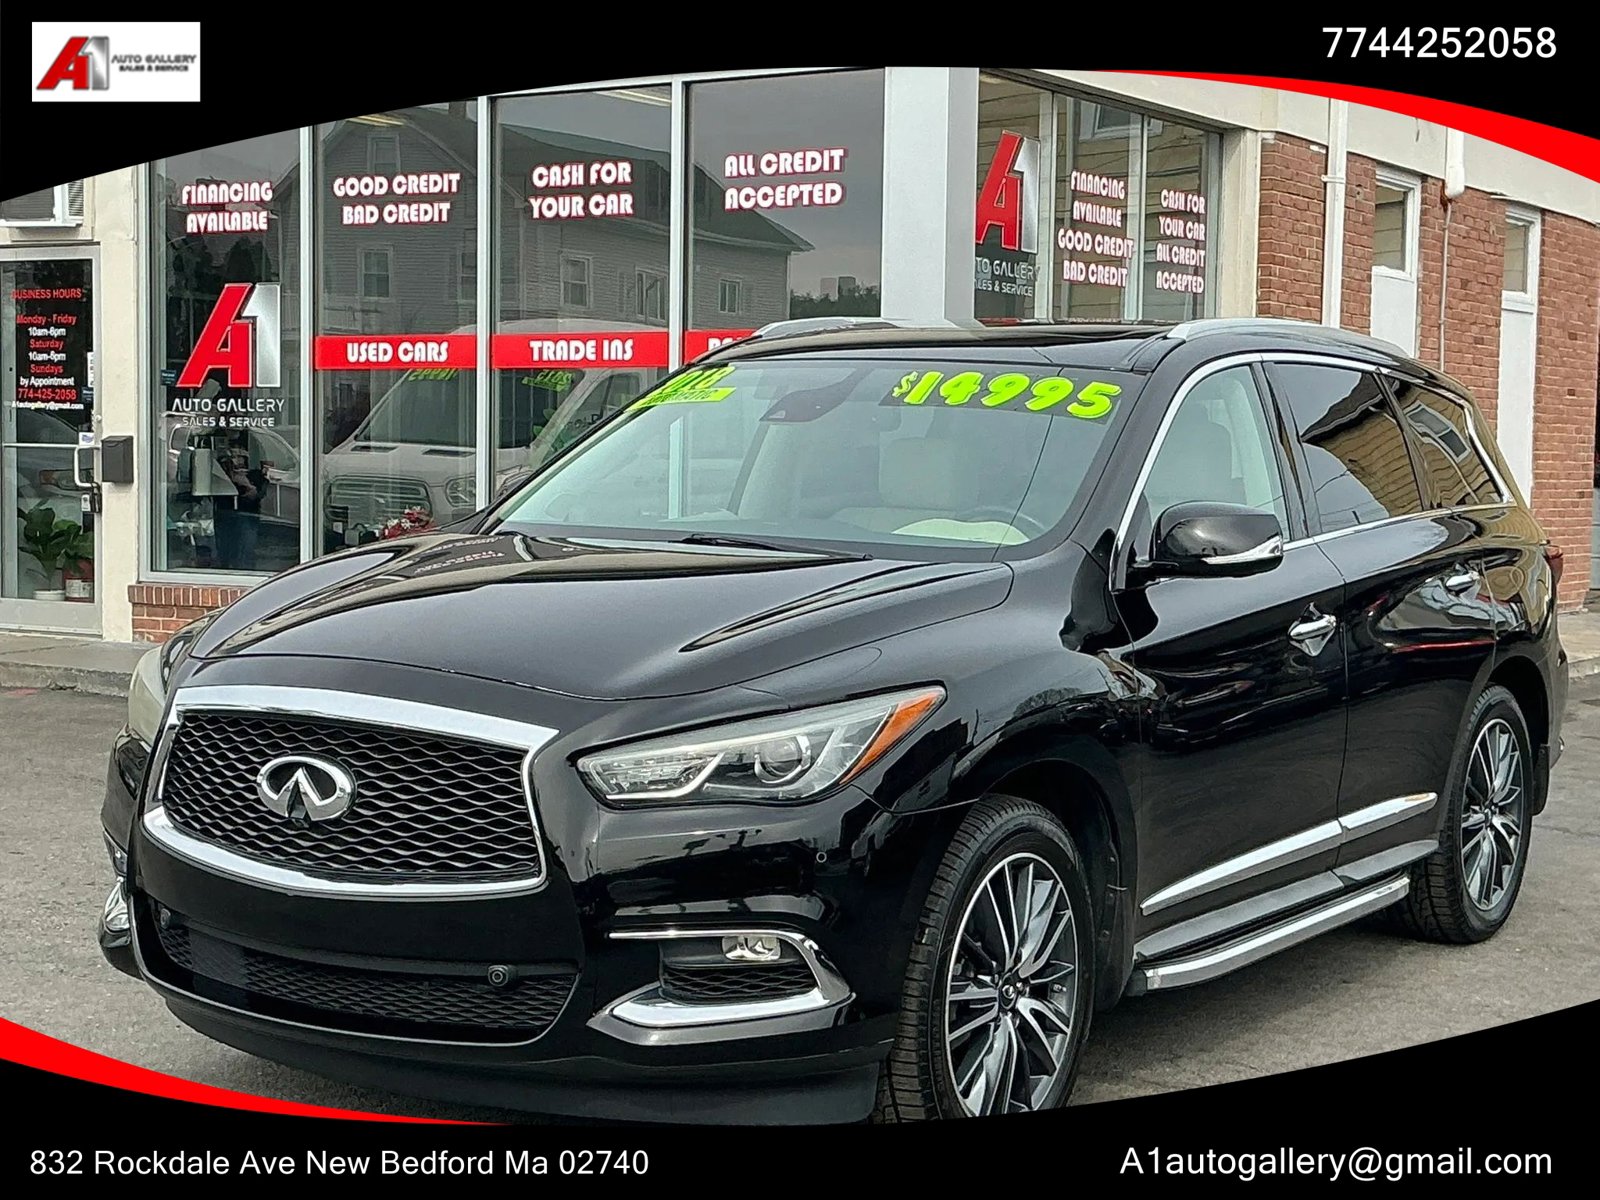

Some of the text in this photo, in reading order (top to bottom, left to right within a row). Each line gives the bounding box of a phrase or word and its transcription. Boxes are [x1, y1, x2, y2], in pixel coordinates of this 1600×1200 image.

[532, 161, 632, 188] CASH FOR
[724, 149, 845, 177] ALL CREDIT
[182, 181, 273, 205] FINANCING
[333, 172, 461, 197] GOOD CREDIT
[724, 182, 843, 210] ACCEPTED
[975, 130, 1040, 255] A1
[1070, 170, 1125, 199] FINANCING
[342, 202, 451, 225] BAD CREDIT
[528, 193, 633, 219] YOUR CAR
[1160, 189, 1205, 214] CASH FOR
[186, 211, 269, 233] AVAILABLE
[1072, 200, 1122, 228] AVAILABLE
[1158, 216, 1205, 241] YOUR CAR
[1057, 228, 1134, 259] GOOD CREDIT
[1156, 243, 1205, 268] ALL CREDIT
[1063, 260, 1128, 287] BAD CREDIT
[1156, 270, 1204, 294] ACCEPTED
[53, 288, 82, 298] HOURS
[1001, 282, 1033, 297] SERVICE
[16, 315, 47, 325] Monday
[53, 314, 77, 325] Friday
[30, 339, 64, 350] Saturday
[176, 283, 281, 388] A1
[346, 341, 449, 363] USED CARS
[530, 338, 633, 361] TRADE INS
[20, 376, 75, 387] by Appointment
[30, 364, 63, 375] Sundays
[18, 388, 77, 400] 774-425-2058
[172, 398, 285, 412] AUTO GALLERY
[892, 370, 1122, 419] $14995
[182, 416, 275, 427] SALES & SERVICE
